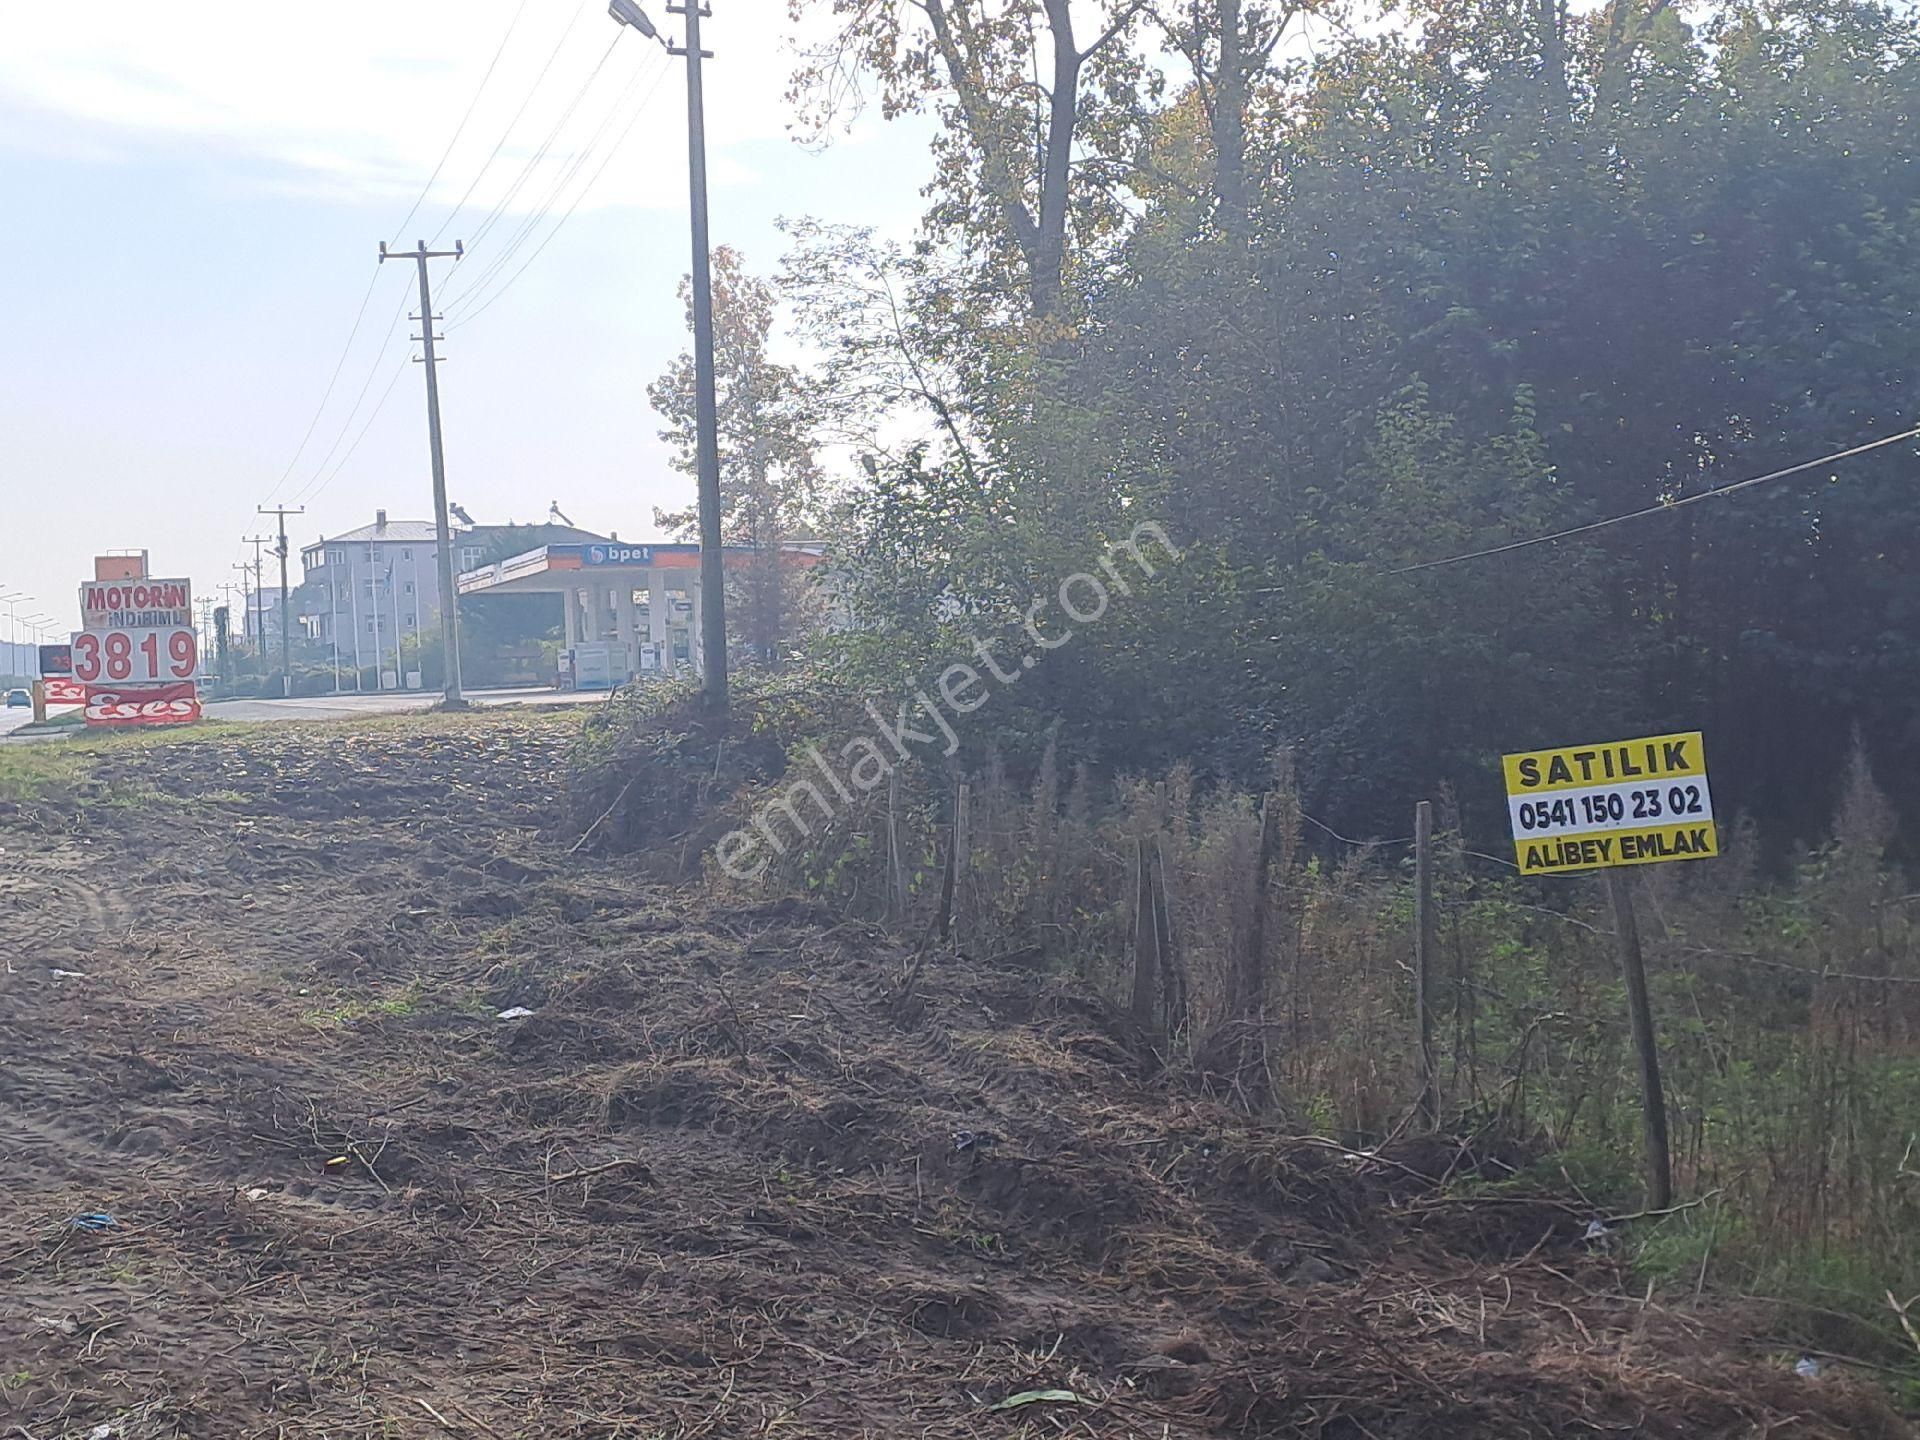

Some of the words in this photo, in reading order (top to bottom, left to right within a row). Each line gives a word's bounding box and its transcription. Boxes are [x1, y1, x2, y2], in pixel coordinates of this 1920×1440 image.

[608, 546, 649, 563] bpet
[74, 631, 196, 681] 3819
[1519, 741, 1690, 787] SATILIK
[1519, 799, 1576, 830] 0541
[1581, 793, 1624, 823] 150
[1631, 789, 1662, 819] 23
[1668, 785, 1702, 815] 02
[1525, 837, 1613, 869] ALİBEY
[1620, 829, 1711, 859] EMLAK
